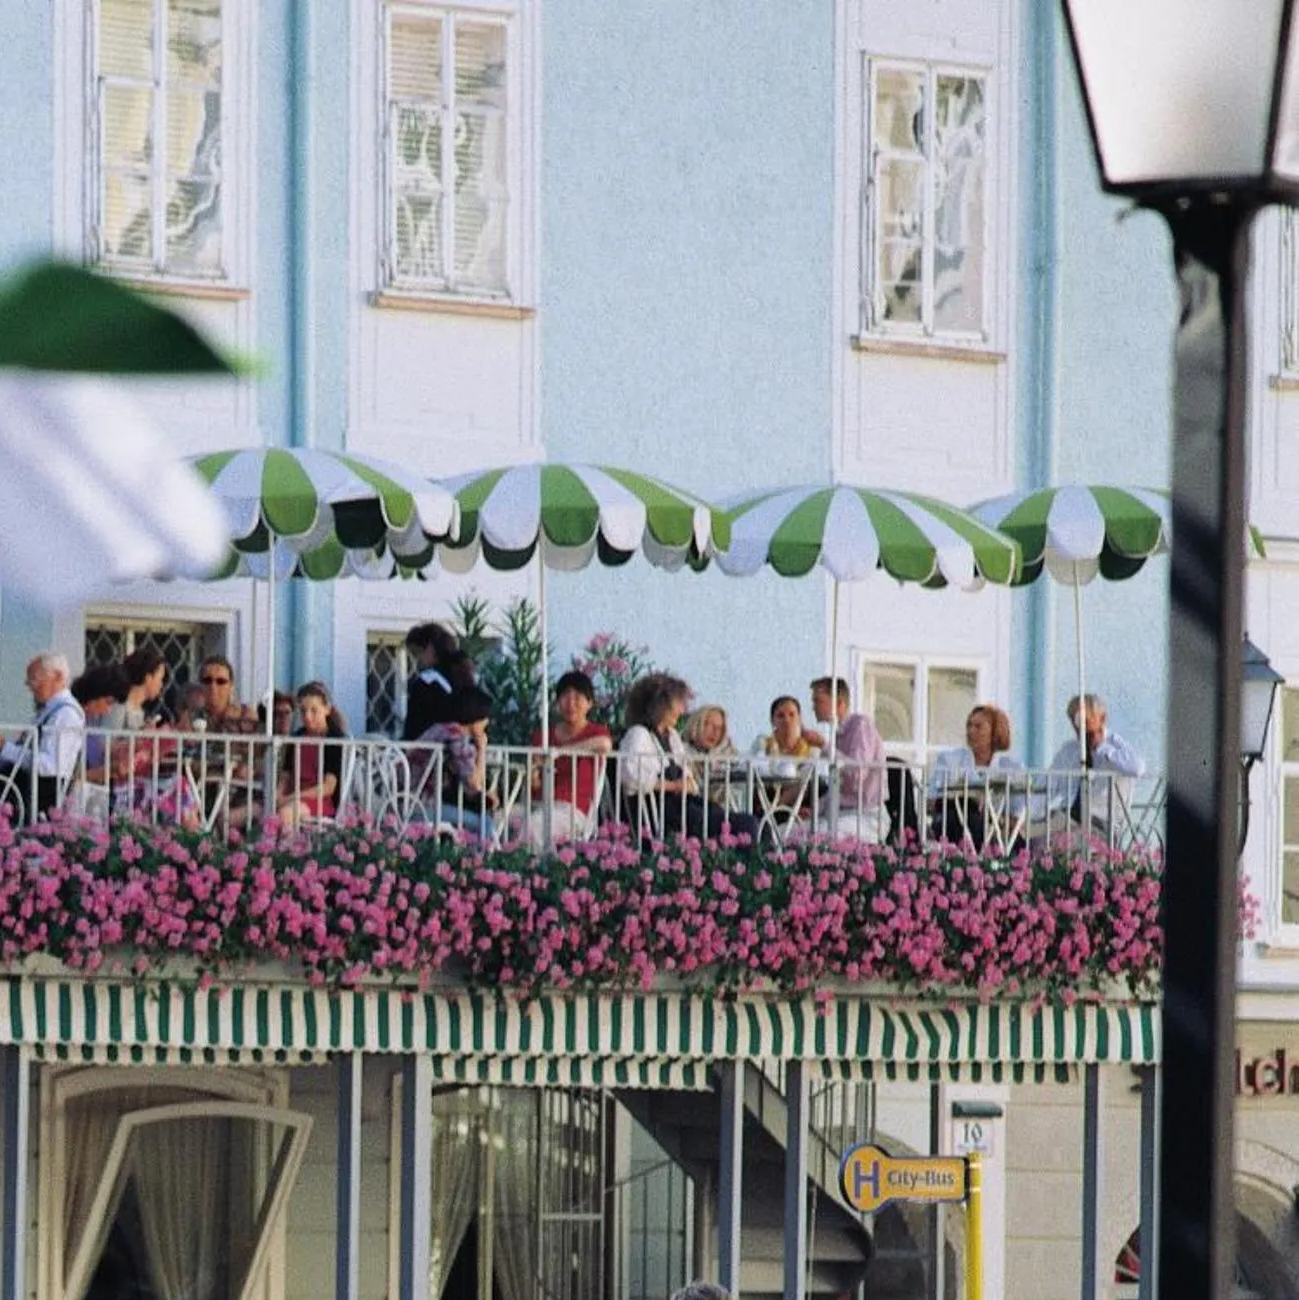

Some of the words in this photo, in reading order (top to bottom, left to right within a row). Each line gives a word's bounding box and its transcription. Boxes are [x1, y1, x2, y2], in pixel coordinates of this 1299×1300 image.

[963, 1123, 983, 1144] 10
[854, 1160, 880, 1199] H
[887, 1169, 955, 1190] City-Bus
